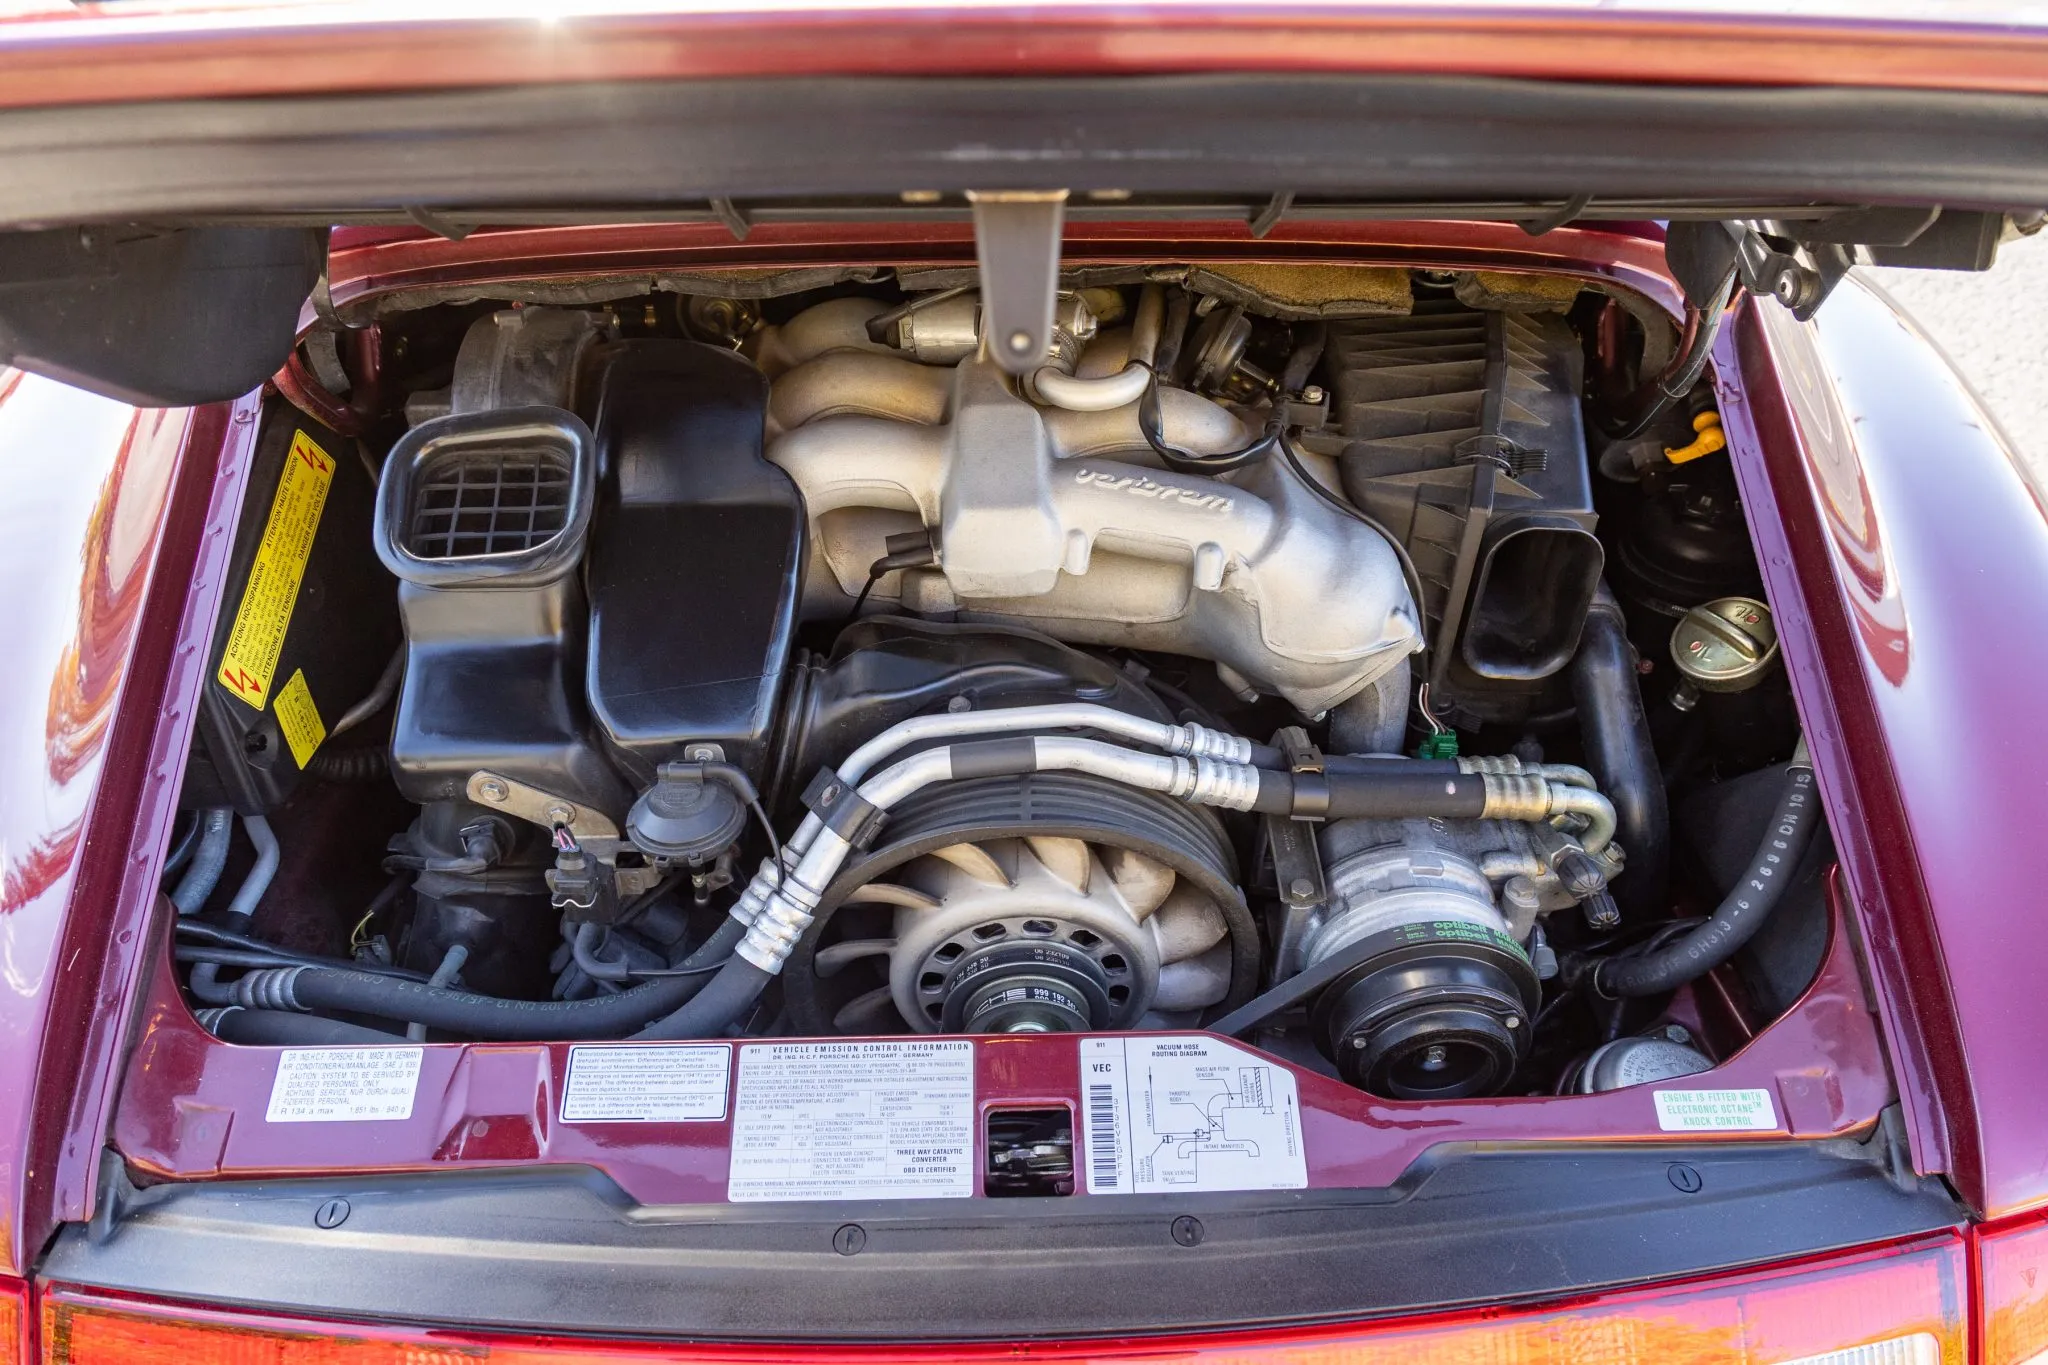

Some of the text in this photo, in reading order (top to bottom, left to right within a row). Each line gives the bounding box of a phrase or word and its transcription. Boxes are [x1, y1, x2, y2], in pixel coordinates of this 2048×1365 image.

[266, 457, 298, 547] ATTENTION HAUTE TENSION
[299, 481, 326, 559] DANGER HIGH VOLTAGE
[231, 561, 265, 658] ACHTUNG HOCHSPANNUNG
[263, 635, 279, 680] ATTENZIONE
[283, 579, 296, 613] TENSIONE
[1433, 921, 1488, 934] optibelt
[1435, 930, 1491, 940] optibelt
[1033, 988, 1049, 997] 999
[1052, 992, 1065, 1002] 192
[814, 1045, 859, 1053] EMISSION
[863, 1044, 902, 1052] CONTROL
[907, 1043, 969, 1051] INFORMATION
[328, 1052, 354, 1060] PORSCHE
[356, 1052, 364, 1060] AG
[369, 1051, 384, 1060] MADE
[395, 1051, 420, 1059] GERMANY
[1092, 1063, 1112, 1073] VEC
[351, 1071, 358, 1079] TO
[361, 1071, 370, 1079] BE
[372, 1070, 404, 1079] SERVICED
[406, 1070, 416, 1078] BY
[287, 1079, 380, 1089] QUALIFIED PERSONNEL ONLY
[350, 1088, 363, 1096] NUR
[366, 1088, 388, 1096] DURCH
[1662, 1091, 1761, 1102] ENGINE IS FITTED WITH
[318, 1097, 350, 1105] PERSONAL
[280, 1107, 287, 1115] R
[291, 1107, 305, 1115] 134
[1667, 1104, 1718, 1115] ELECTRONIC
[1683, 1116, 1753, 1126] KNOCK CONTROL
[1284, 1111, 1294, 1157] DRIVING DIRECTION
